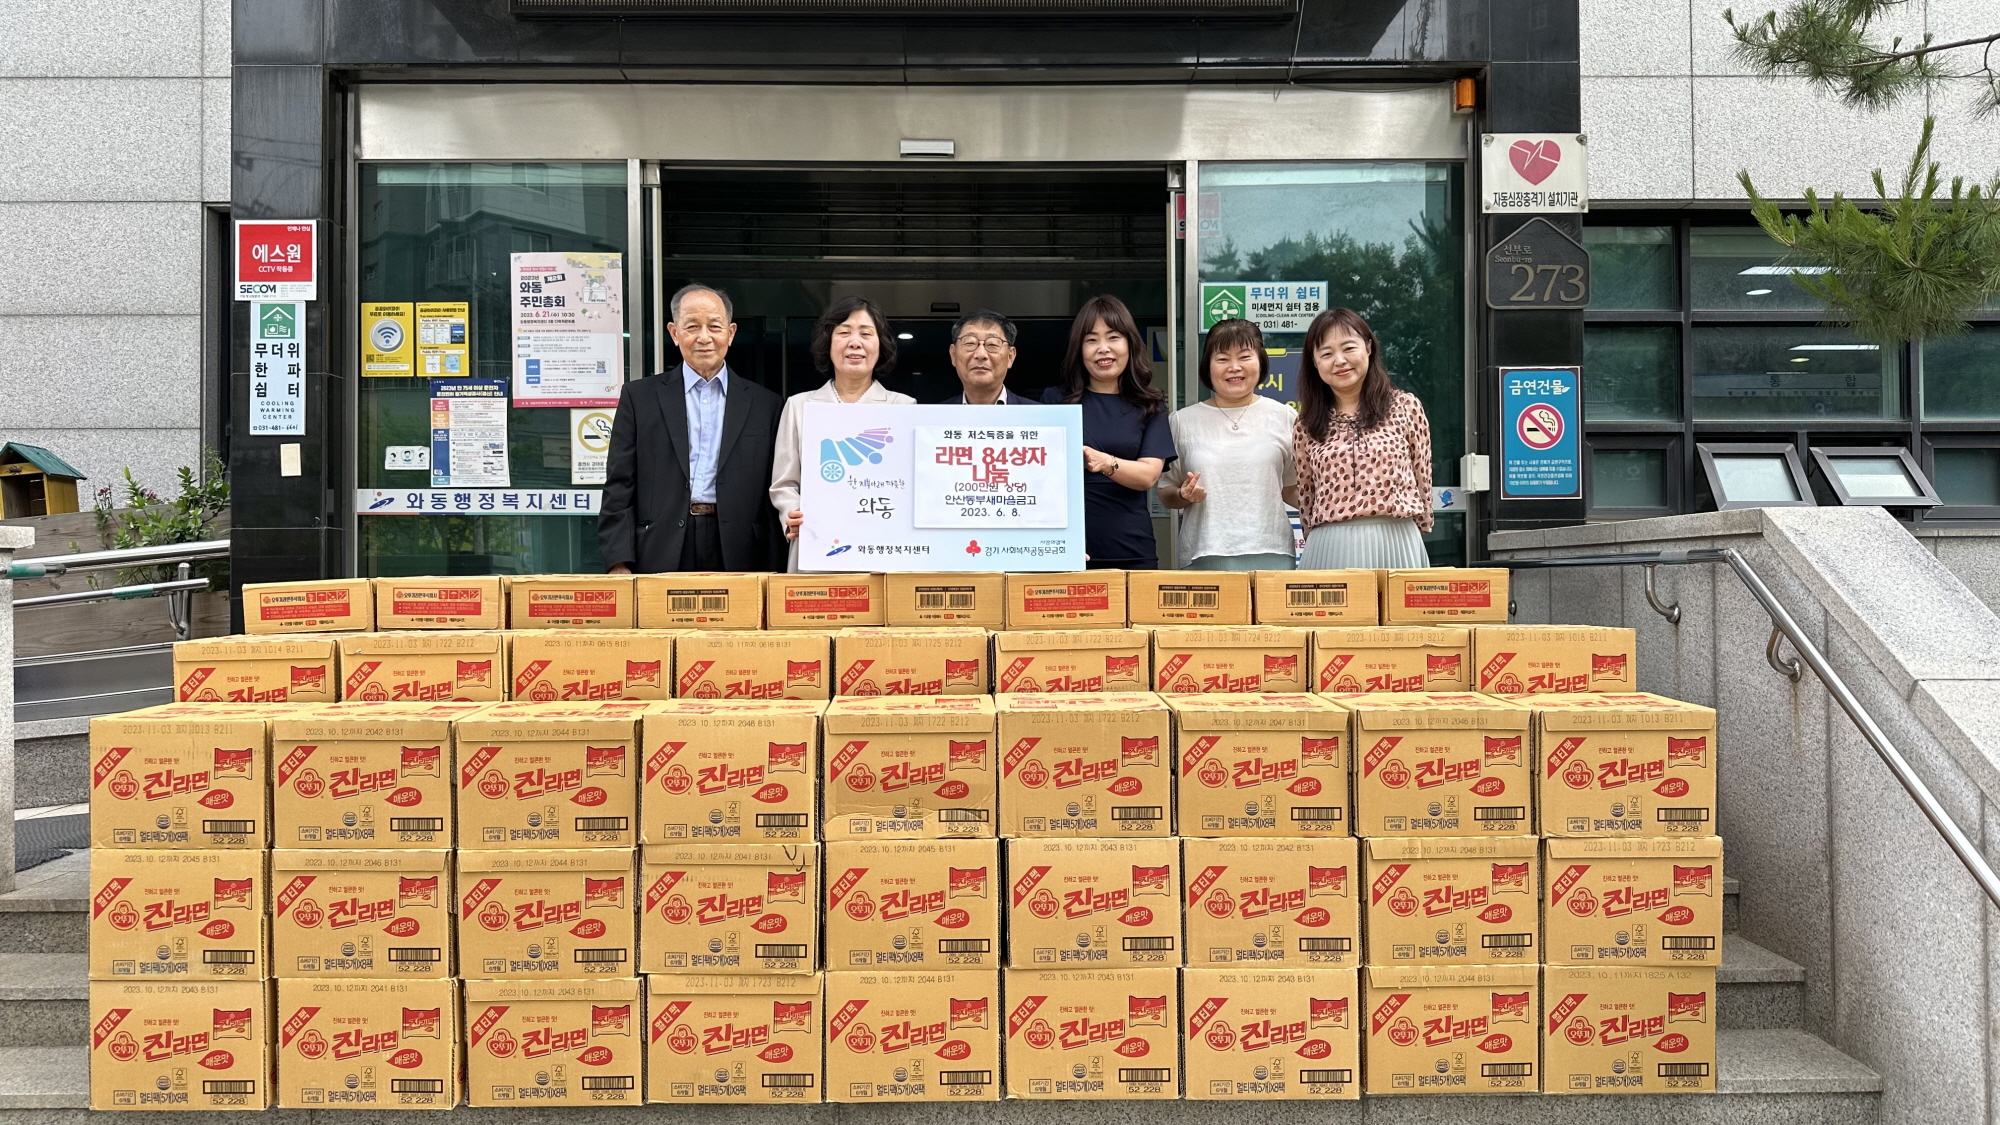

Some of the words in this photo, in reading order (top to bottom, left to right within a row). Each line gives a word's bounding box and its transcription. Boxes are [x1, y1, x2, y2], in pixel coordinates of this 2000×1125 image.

[1493, 192, 1546, 207] 자동심장충격기
[1548, 192, 1578, 207] 설치기관
[252, 244, 301, 263] 에스원
[1504, 245, 1532, 255] 선부로
[240, 284, 276, 293] SECOM
[520, 282, 542, 293] 와동
[1509, 264, 1586, 302] 273
[520, 296, 565, 307] 주민총회
[1250, 287, 1288, 299] 무더위
[1296, 287, 1320, 299] 쉼터
[1252, 303, 1283, 311] 미세먼지
[1286, 303, 1301, 311] 쉼터
[1304, 303, 1320, 311] 겸용
[255, 343, 299, 358] 무더위
[1509, 380, 1564, 395] 금연건물
[944, 430, 962, 439] 와동
[1020, 430, 1038, 439] 위한
[936, 446, 972, 465] 라면
[982, 447, 1047, 466] 84상자
[847, 475, 857, 489] 한
[973, 464, 1009, 483] 나눔
[955, 482, 999, 492] (200만원
[1004, 482, 1027, 492] 상당)
[407, 492, 590, 510] 와동행정복지센터
[857, 497, 895, 519] 와동
[945, 495, 1036, 505] 안산동부새마을금고
[961, 508, 990, 516] 2023.
[996, 508, 1005, 516] 6.
[1012, 508, 1021, 516] 8.
[858, 545, 930, 554] 와동행정복지센터
[985, 547, 999, 556] 경기
[1550, 740, 1577, 768] 멀티팩
[696, 764, 765, 796] 진라면
[880, 762, 946, 793] 진라면
[1052, 758, 1120, 789] 진라면
[1232, 758, 1300, 789] 진라면
[1415, 759, 1481, 790] 진라면
[1568, 774, 1589, 783] 오뚜기
[1598, 759, 1666, 790] 진라면
[143, 770, 211, 801] 진라면
[329, 768, 398, 800] 진라면
[513, 768, 583, 801] 진라면
[758, 786, 785, 801] 매운맛
[1113, 780, 1138, 794] 매운맛
[1659, 781, 1685, 796] 매운맛
[204, 792, 231, 807] 매운맛
[1016, 870, 1042, 898] 멀티팩
[696, 894, 765, 926] 진라면
[879, 890, 947, 921] 진라면
[1063, 888, 1131, 919] 진라면
[1239, 888, 1307, 919] 진라면
[1422, 886, 1490, 917] 진라면
[1602, 887, 1671, 919] 진라면
[143, 900, 212, 932] 진라면
[327, 898, 396, 930] 진라면
[513, 900, 582, 932] 진라면
[667, 908, 687, 917] 오뚜기
[940, 912, 966, 926] 매운맛
[1483, 907, 1508, 921] 매운맛
[390, 920, 416, 934] 매운맛
[702, 1024, 771, 1056] 진라면
[880, 1022, 948, 1053] 진라면
[1059, 1019, 1127, 1050] 진라면
[1240, 1021, 1308, 1052] 진라면
[1423, 1016, 1489, 1047] 진라면
[1599, 1015, 1665, 1046] 진라면
[113, 1046, 134, 1055] 오뚜기
[143, 1031, 211, 1062] 진라면
[331, 1029, 400, 1061] 진라면
[521, 1028, 589, 1059] 진라면
[1302, 1042, 1328, 1056] 매운맛
[1659, 1036, 1685, 1050] 매운맛
[583, 1049, 609, 1064] 매운맛
